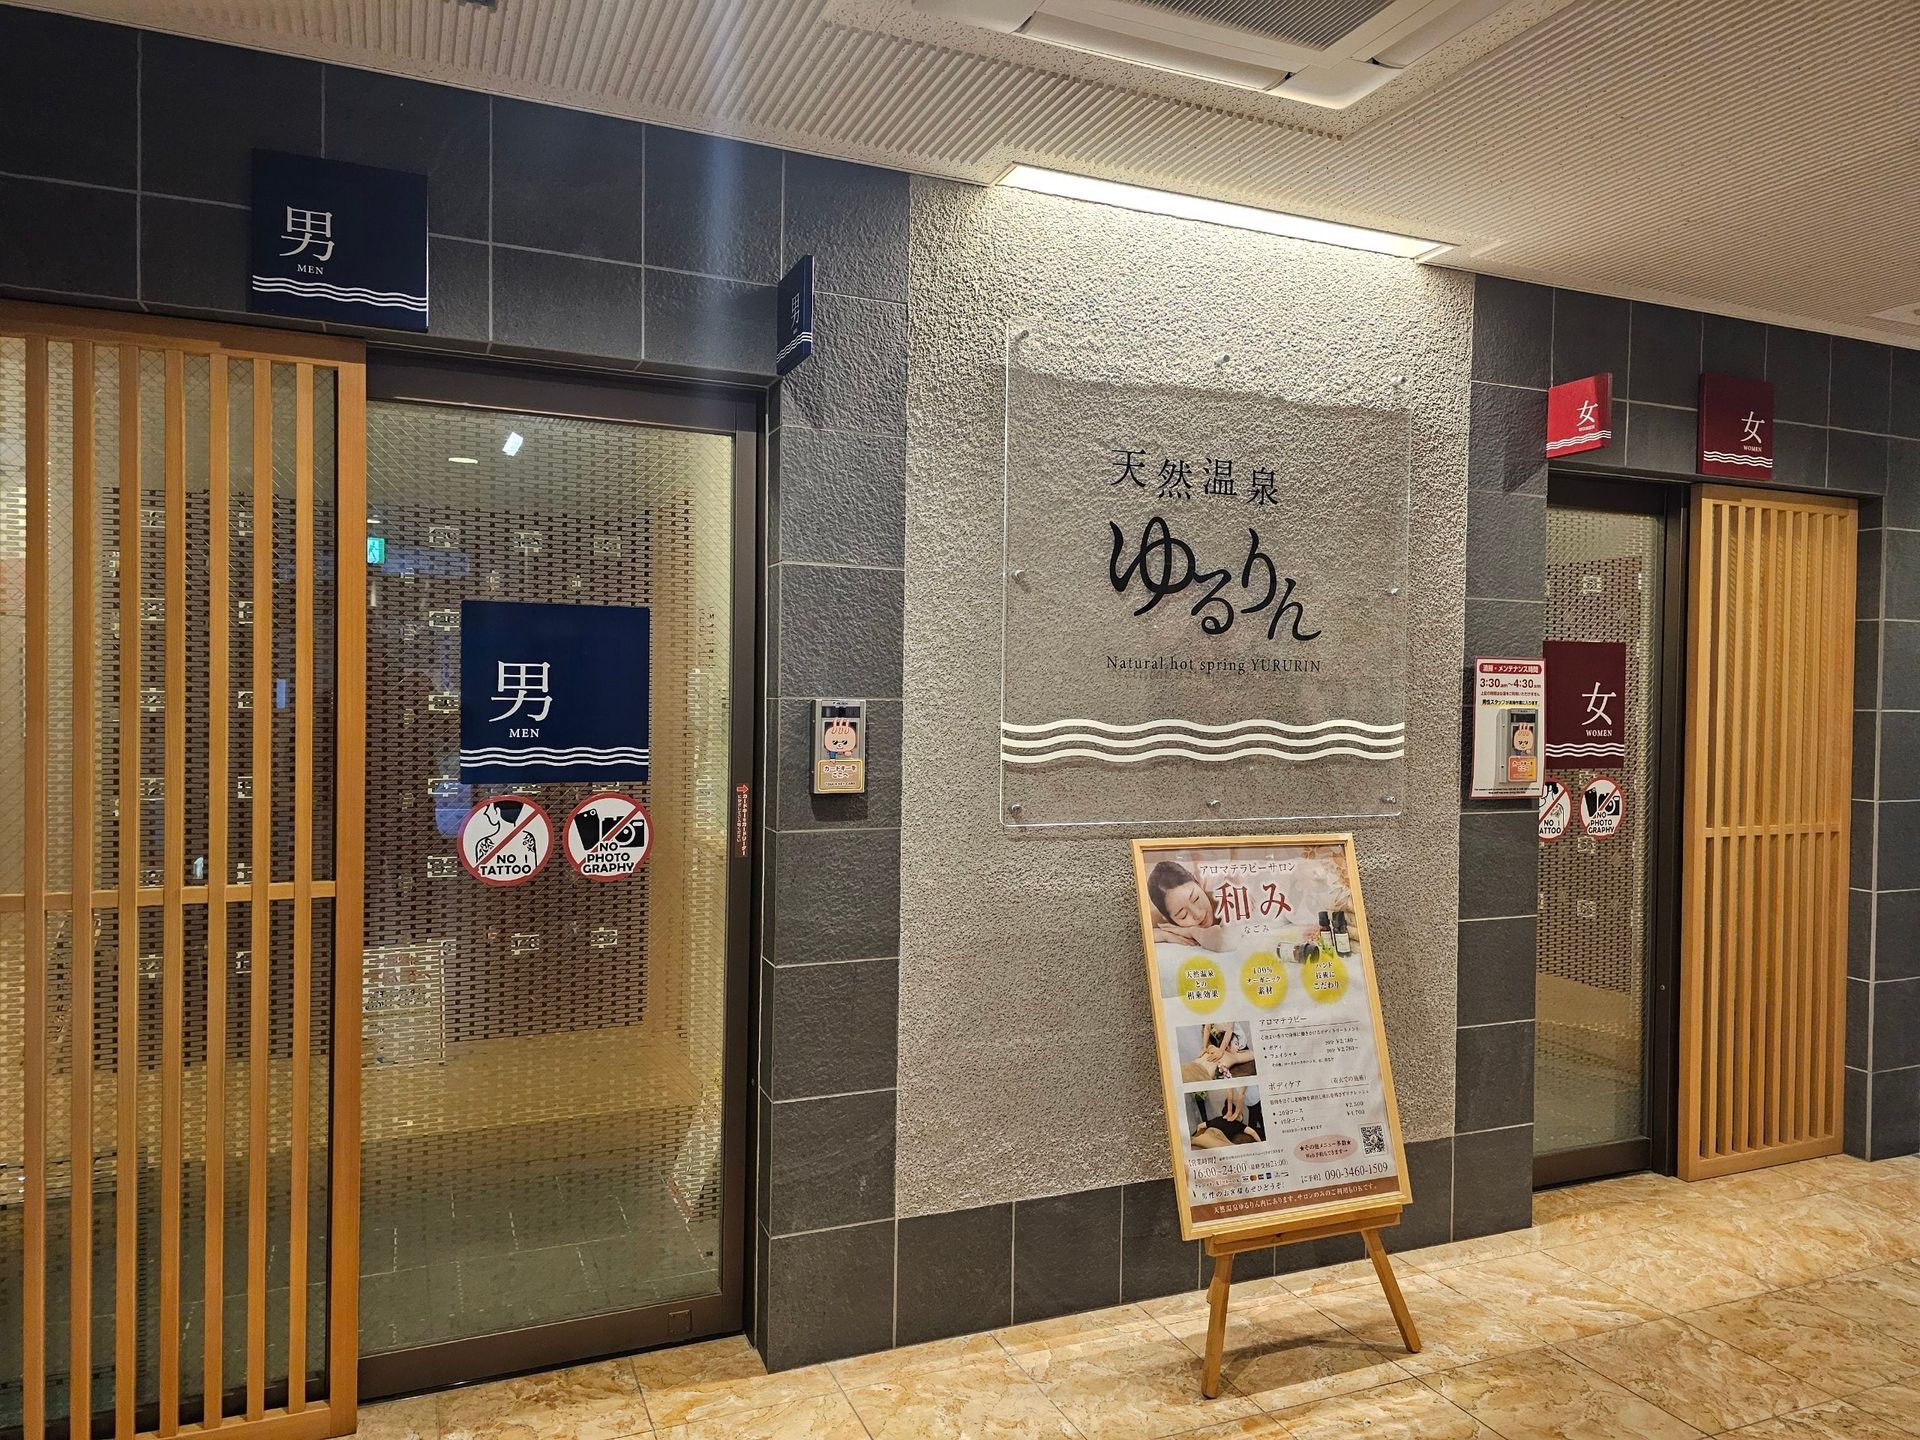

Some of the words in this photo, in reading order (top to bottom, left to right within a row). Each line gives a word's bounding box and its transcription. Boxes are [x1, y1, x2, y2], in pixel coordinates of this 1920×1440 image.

[279, 205, 335, 262] 男
[296, 263, 325, 276] MEN
[790, 292, 800, 331] 男
[1576, 400, 1599, 427] 女
[1578, 424, 1596, 432] WOMEN
[1740, 411, 1766, 444] 女
[1743, 445, 1763, 453] WOMEN
[1110, 448, 1279, 506] 天然温泉
[1108, 516, 1322, 641] ゆるりん
[1106, 655, 1164, 670] Natural
[1170, 656, 1194, 671] hot
[1200, 657, 1246, 676] spring
[1251, 657, 1321, 673] YURURIN
[488, 660, 553, 722] 男
[1581, 681, 1617, 726] 女
[508, 728, 540, 738] MEN
[1586, 729, 1613, 737] WOMEN
[1596, 811, 1607, 819] NO
[1543, 819, 1554, 827] NO
[1590, 818, 1613, 827] PHOTO
[1539, 827, 1562, 835] ATTOO
[1588, 826, 1615, 835] GRAPHY
[599, 841, 619, 852] NO
[496, 854, 517, 864] NO
[586, 852, 630, 864] PHOTO
[480, 864, 532, 876] TATTOO
[582, 861, 635, 875] GRAPHY
[1200, 862, 1295, 874] アロマテラピーサロン
[1215, 882, 1292, 924] 和み
[1244, 924, 1270, 934] なごみ
[1186, 969, 1215, 979] 天然温泉
[1247, 975, 1281, 984] オーガニック
[1315, 970, 1336, 979] 技術に
[1195, 980, 1207, 988] との
[1313, 981, 1340, 991] こだわり
[1257, 986, 1273, 995] 素材
[1268, 1080, 1301, 1091] ボディケア
[1324, 1162, 1388, 1181] 090-3460-1509
